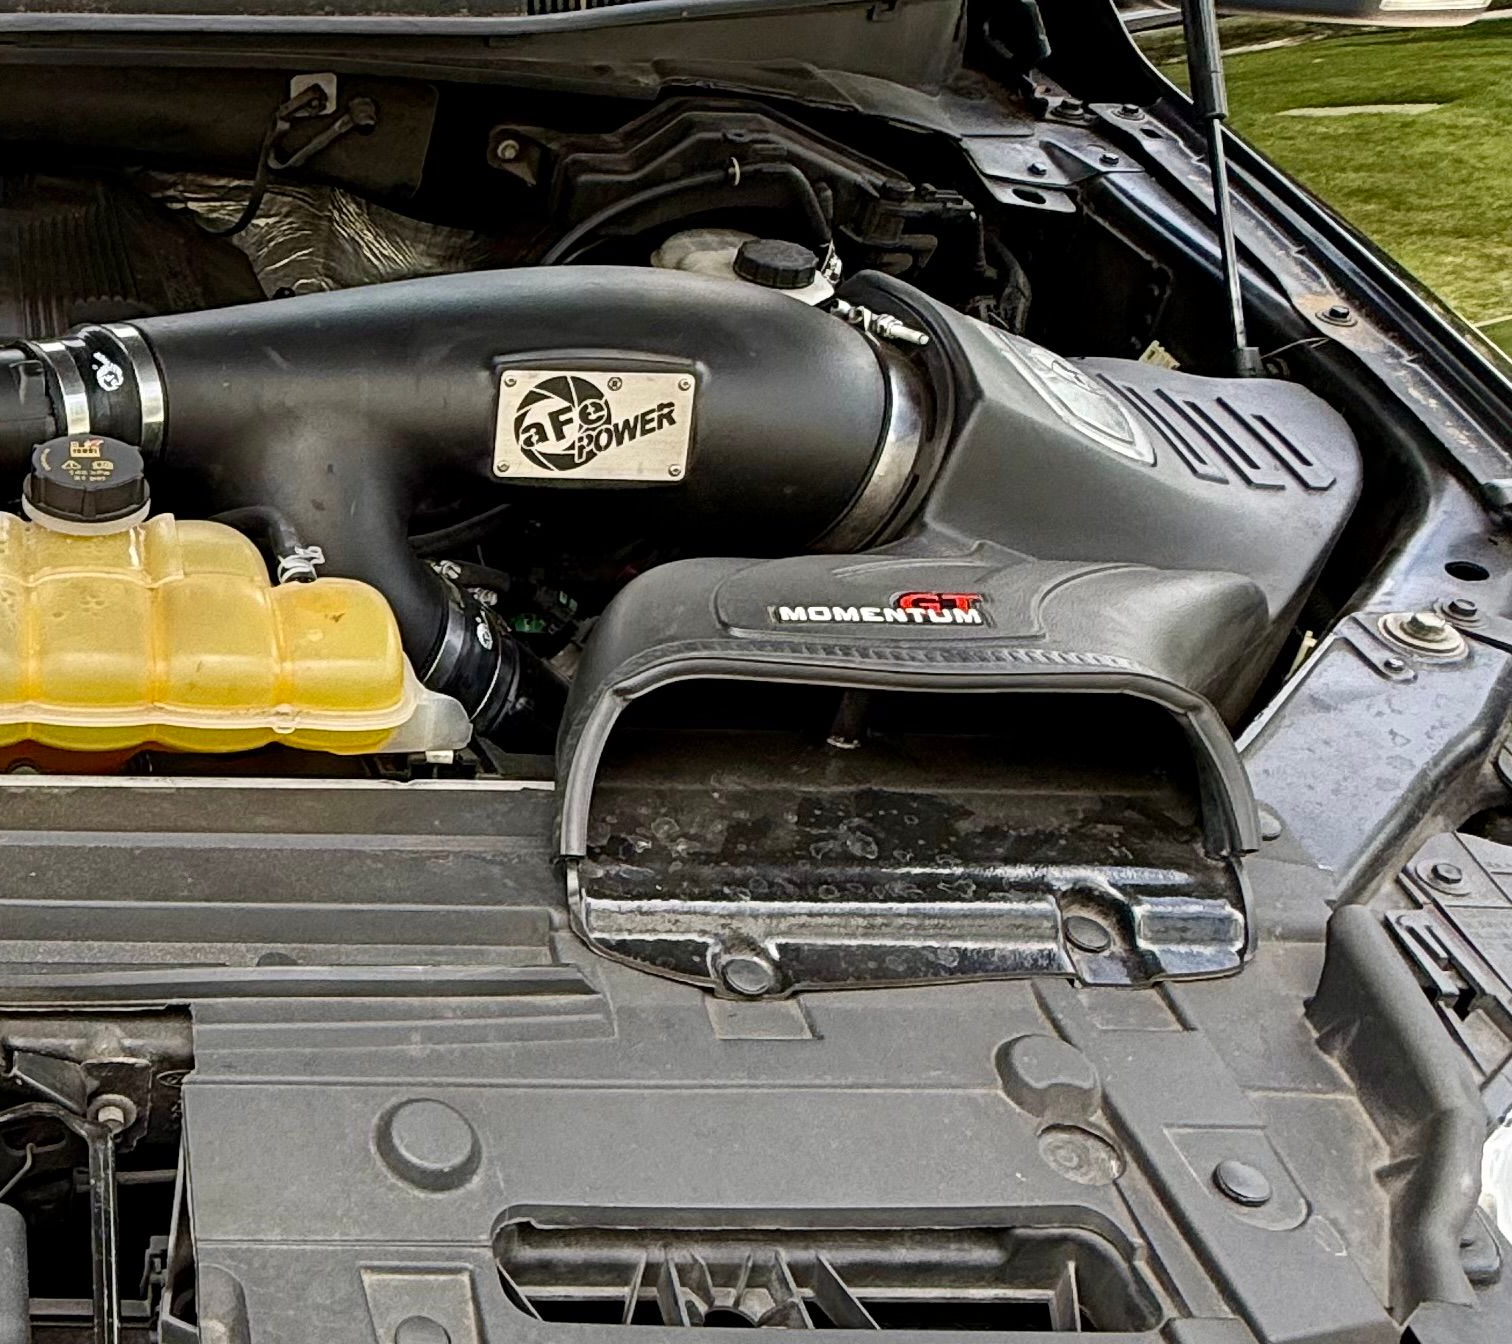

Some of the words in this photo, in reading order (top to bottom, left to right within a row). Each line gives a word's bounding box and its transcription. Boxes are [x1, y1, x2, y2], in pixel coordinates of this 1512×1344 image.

[520, 399, 608, 449] aFe
[574, 401, 677, 463] POWER
[778, 605, 983, 624] MOMENTUM
[897, 592, 983, 614] GT
